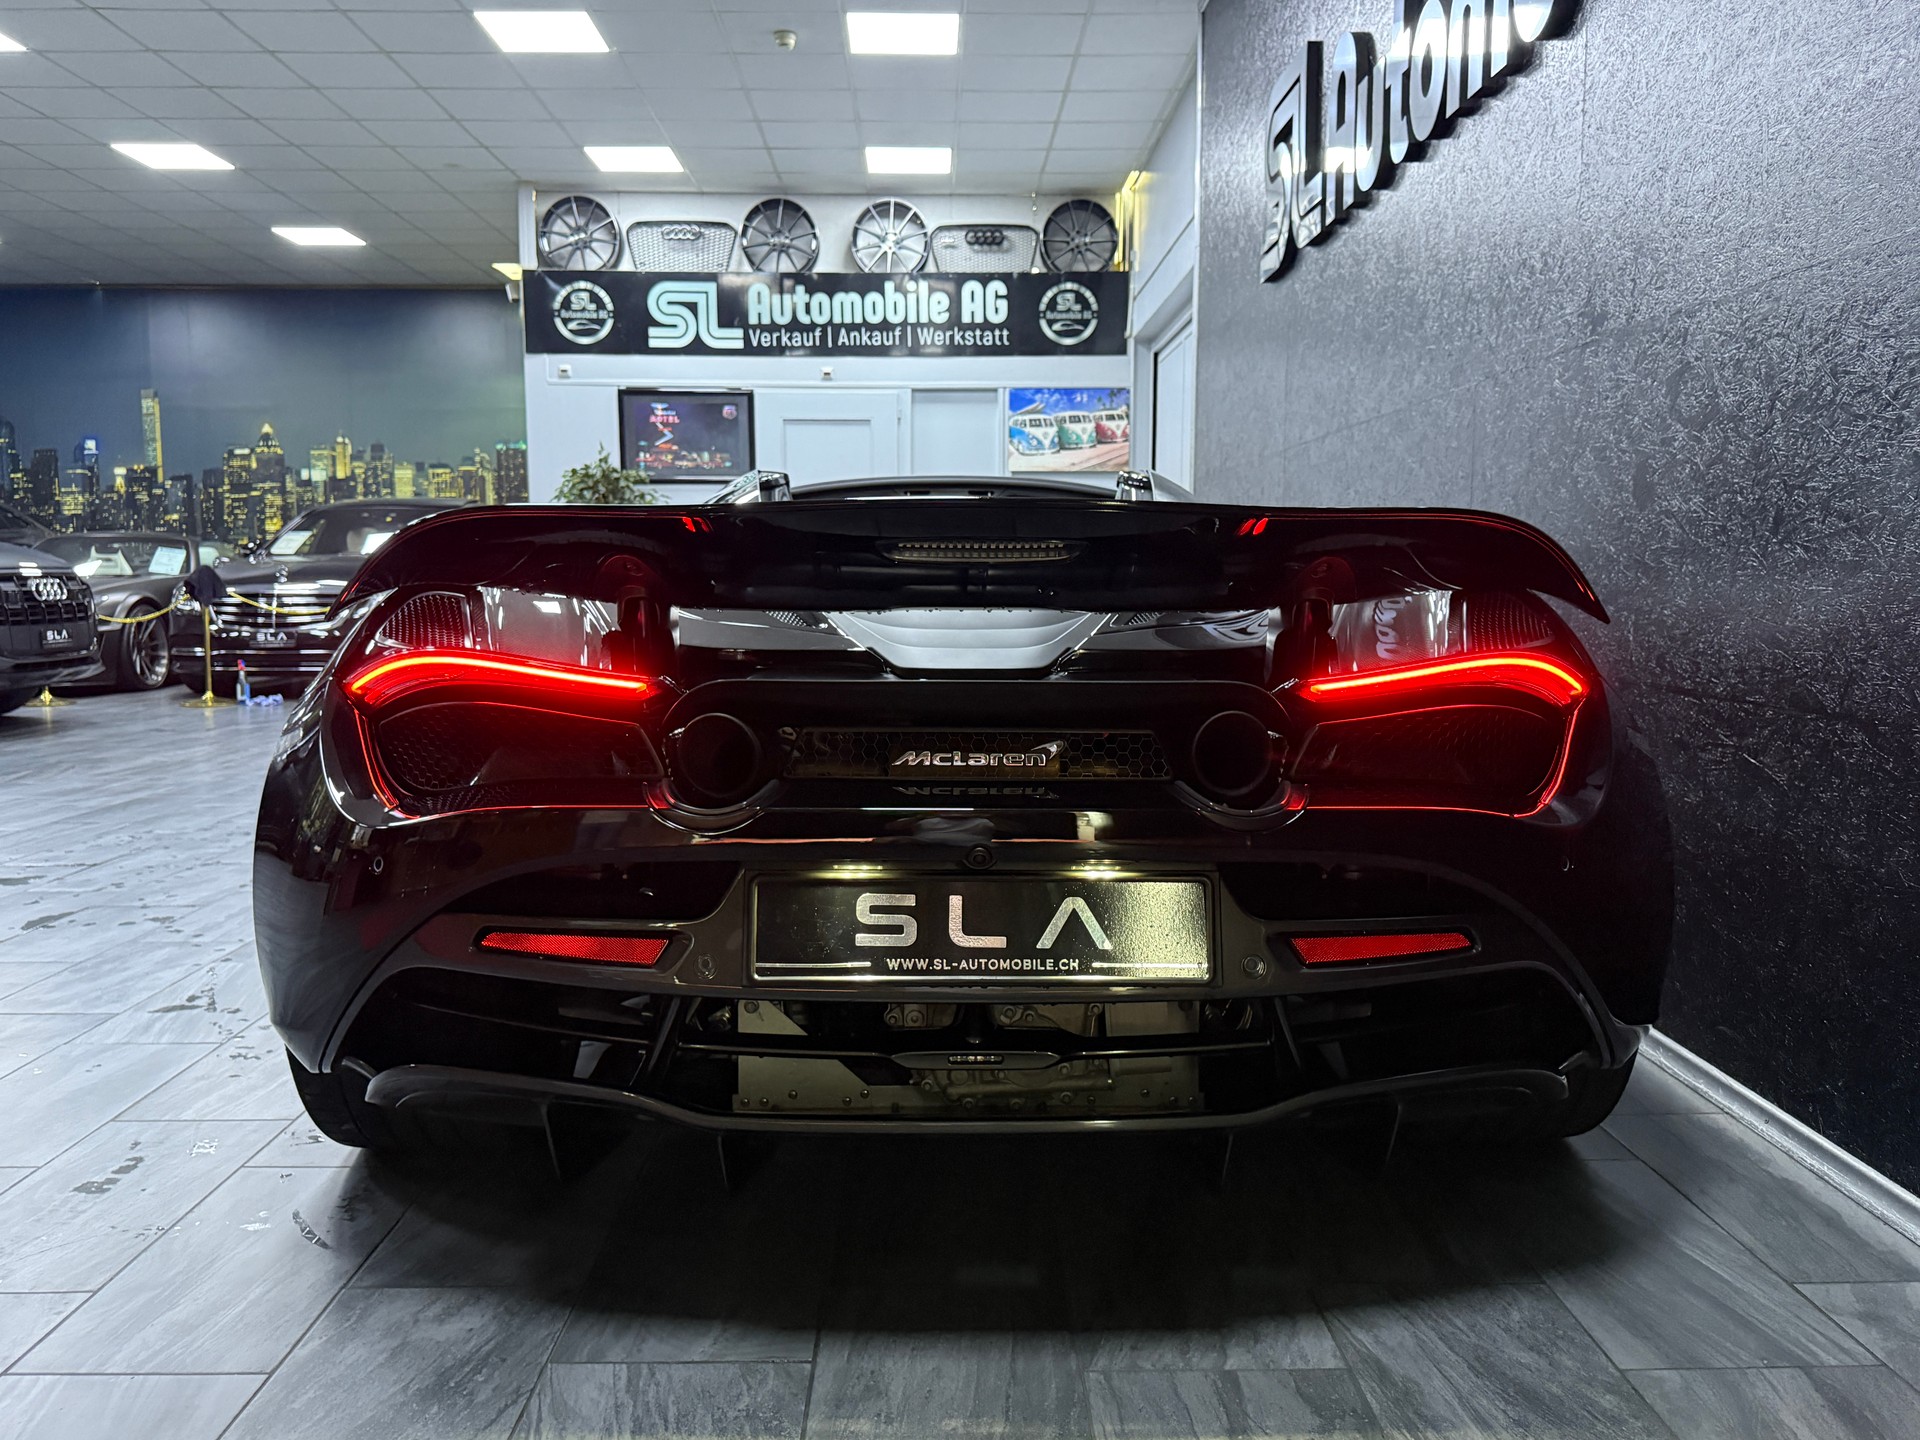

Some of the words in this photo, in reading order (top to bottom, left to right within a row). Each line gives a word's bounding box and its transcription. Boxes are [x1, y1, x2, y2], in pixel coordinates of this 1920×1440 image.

[646, 280, 745, 349] SL
[747, 280, 950, 326] Automobile
[961, 279, 1009, 325] AG
[748, 327, 822, 348] Verkauf
[837, 326, 902, 347] Ankauf
[916, 326, 1011, 347] Werkstatt
[891, 750, 1047, 767] McLaren
[886, 958, 1080, 971] WWW.SL-AUTOMOBILE.CH
